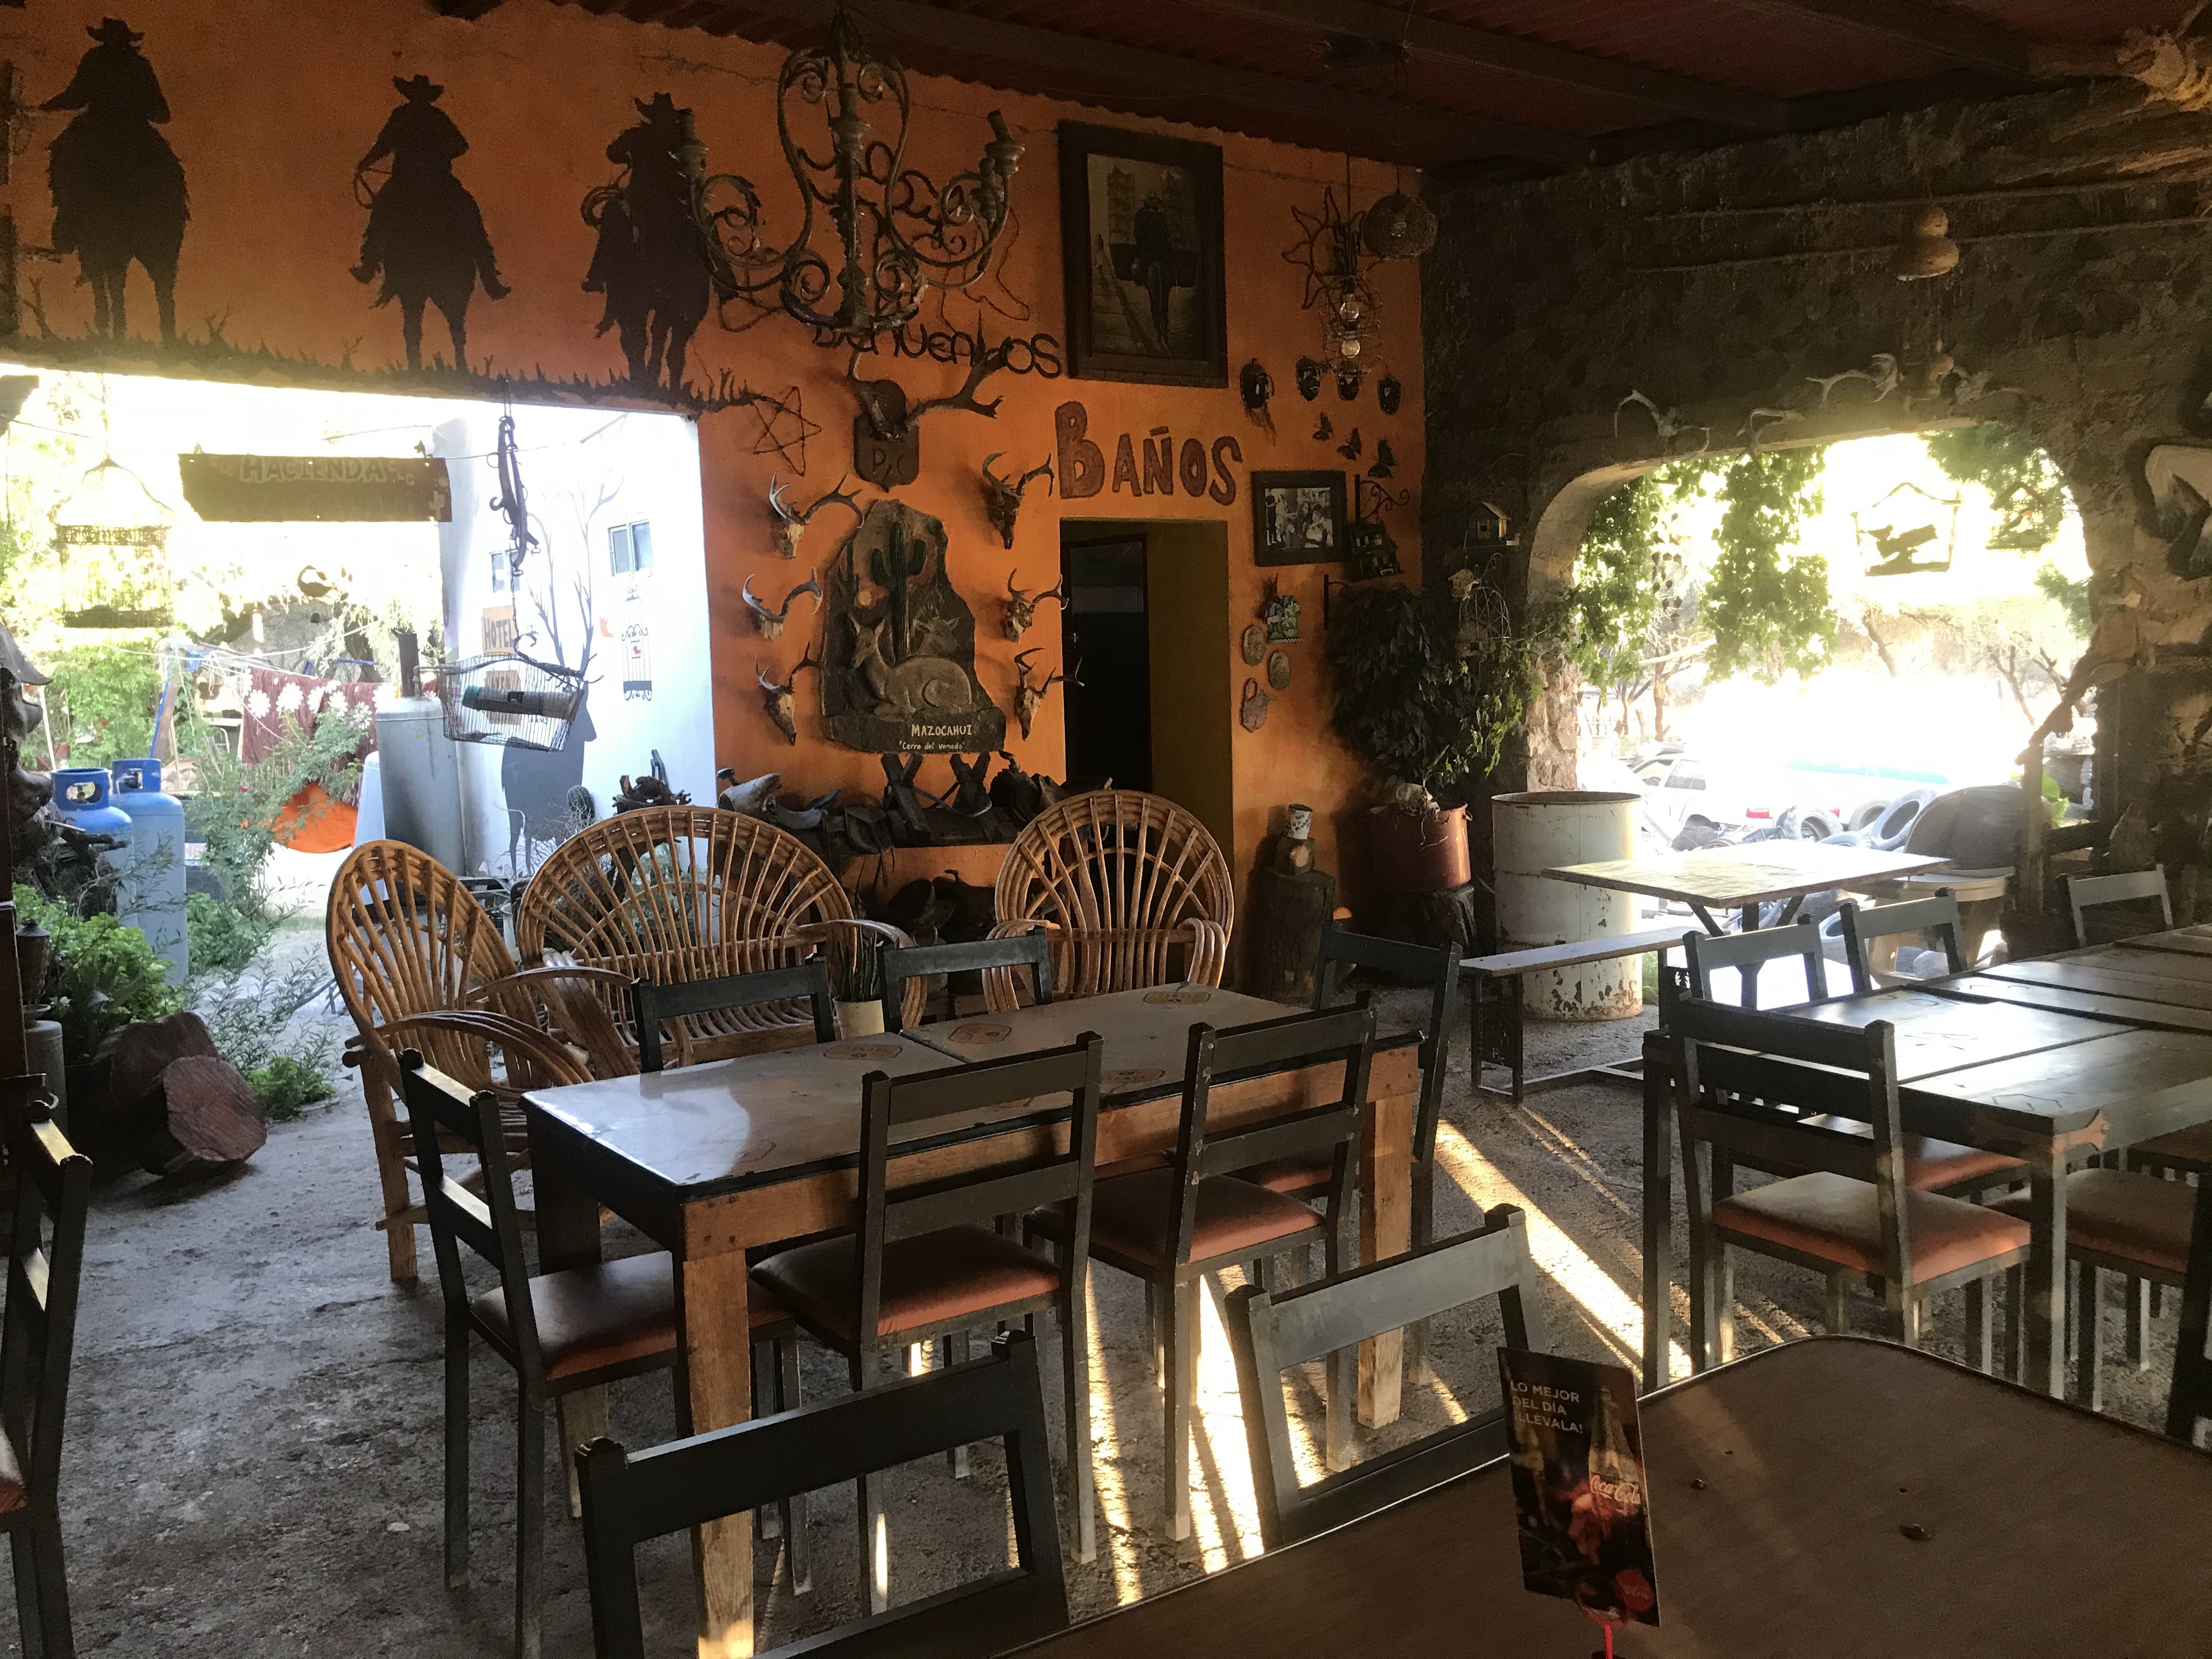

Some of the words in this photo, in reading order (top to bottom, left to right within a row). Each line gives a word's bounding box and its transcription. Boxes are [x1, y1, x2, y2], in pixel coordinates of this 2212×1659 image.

[1055, 400, 1243, 506] BAÑOS
[239, 456, 388, 484] HACIENDA
[483, 618, 514, 650] HOTEL
[911, 724, 973, 737] MAZOCAHUI
[924, 742, 935, 751] del
[1510, 1380, 1528, 1392] LO
[1532, 1384, 1580, 1403] MEJOR
[1512, 1396, 1539, 1410] DEL
[1541, 1400, 1567, 1416] DÍA
[1590, 1475, 1641, 1505] Coca-Cola
